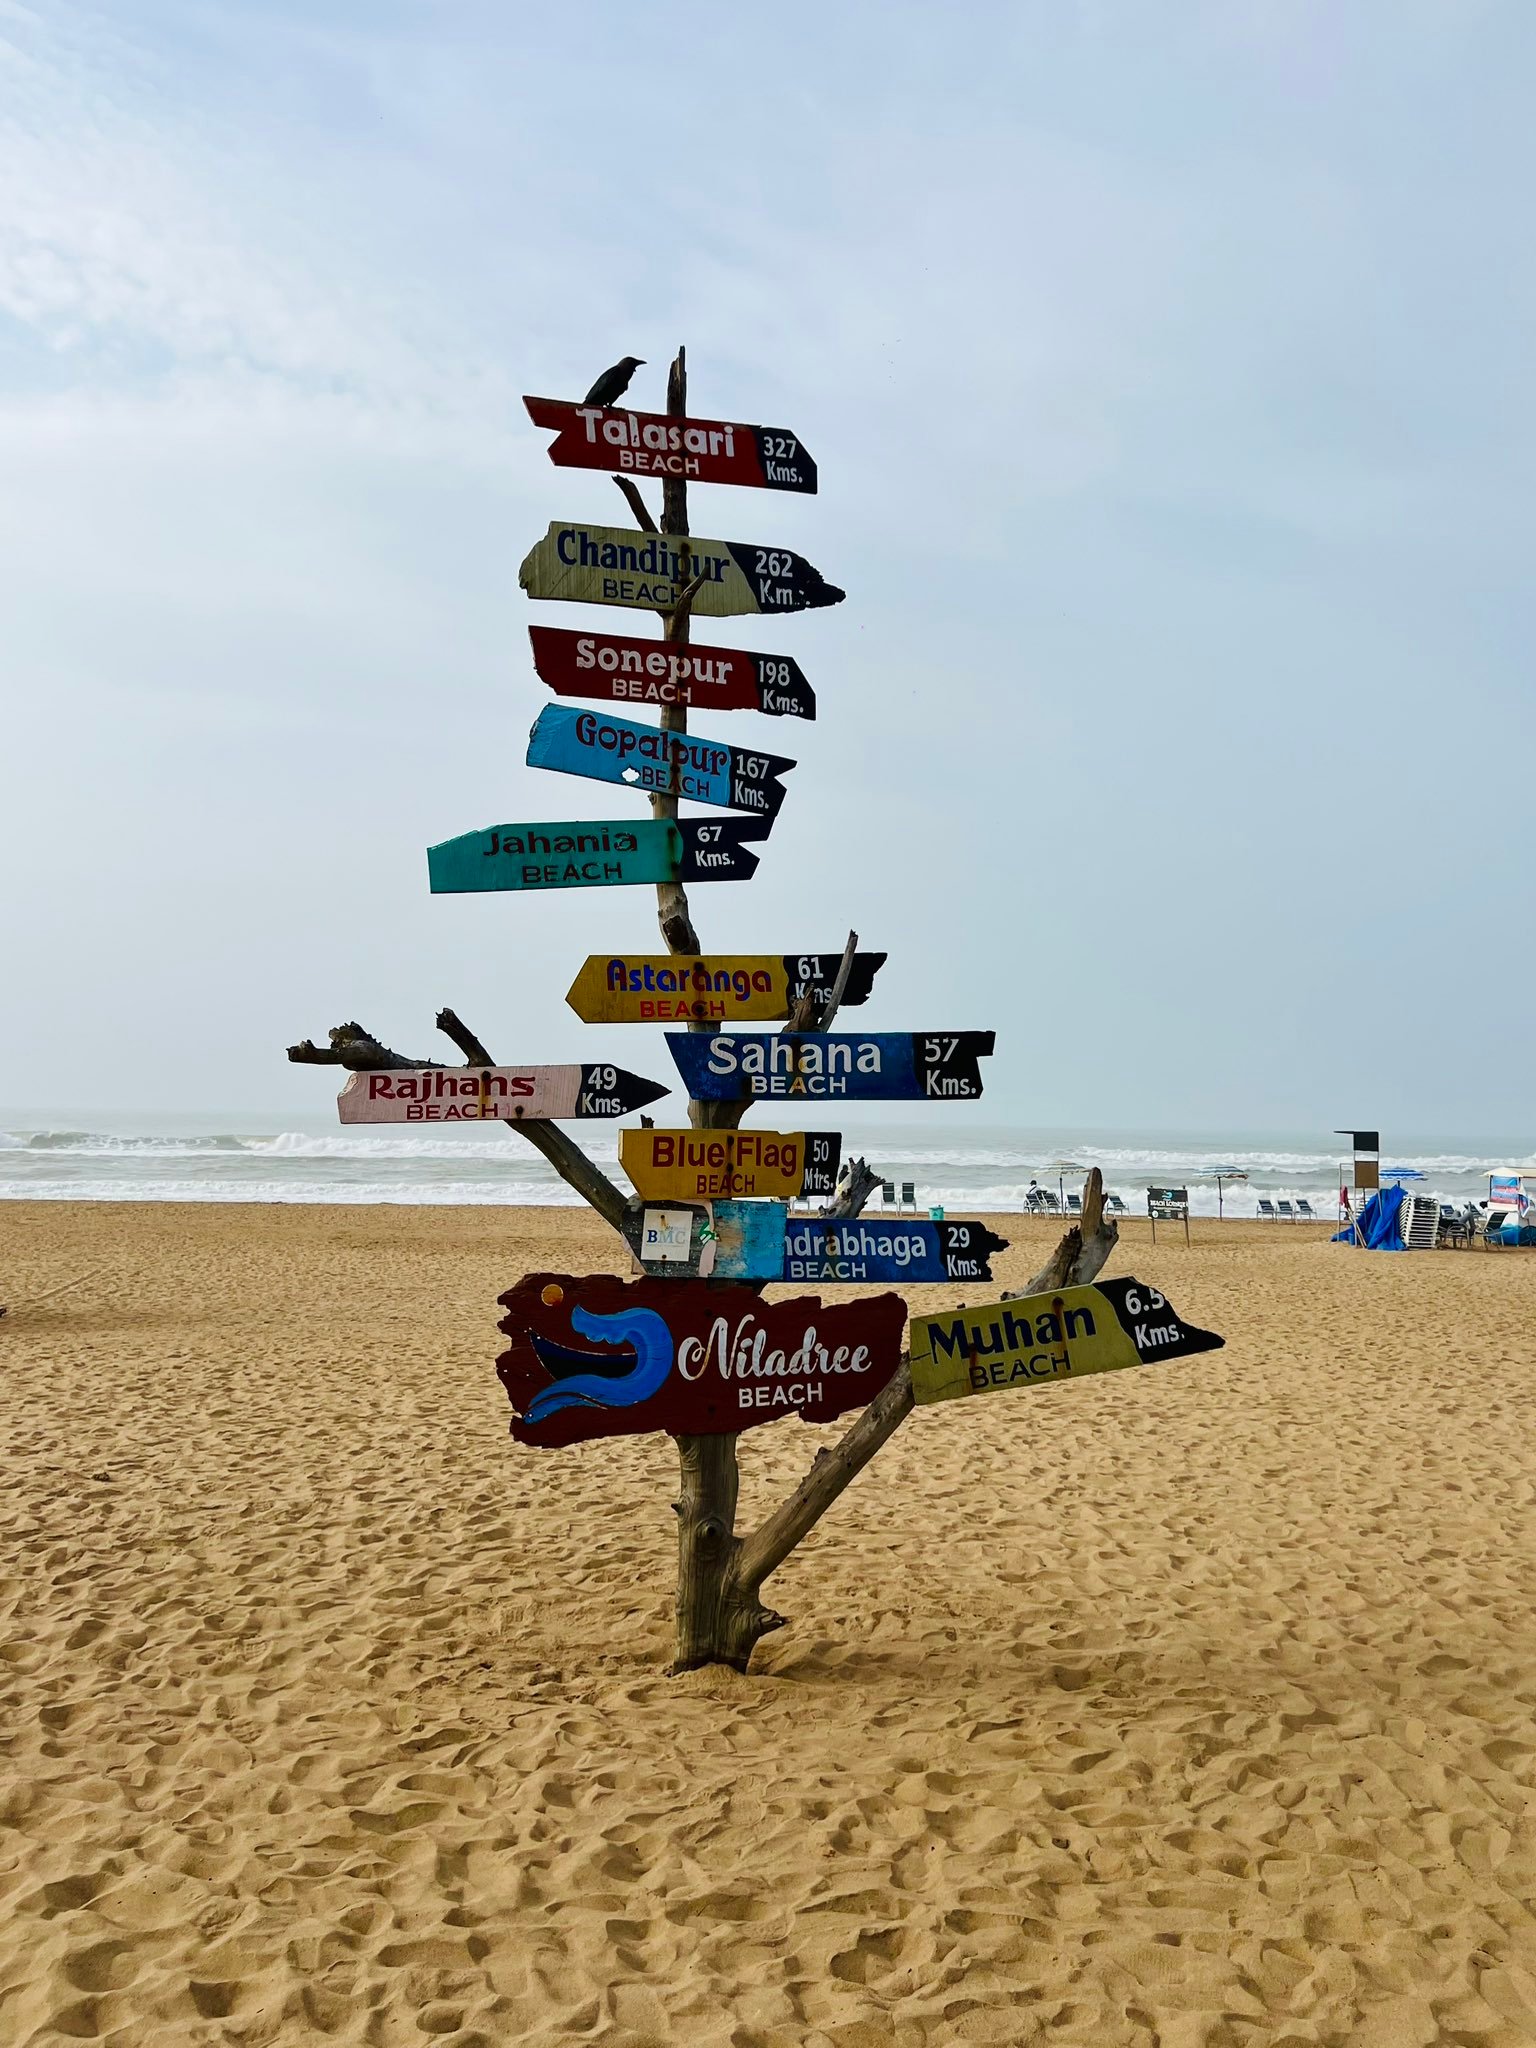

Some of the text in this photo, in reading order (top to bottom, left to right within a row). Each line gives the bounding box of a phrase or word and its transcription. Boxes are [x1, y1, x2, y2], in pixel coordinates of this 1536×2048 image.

[576, 408, 735, 457] Talasari
[763, 436, 797, 459] 327
[619, 450, 700, 475] BEACH
[766, 461, 804, 483] Kms.
[556, 529, 730, 584] Chandipur
[755, 550, 793, 578] 262
[576, 639, 733, 685] Sonepur
[758, 660, 790, 686] 198
[612, 678, 692, 703] BEACH
[763, 689, 804, 713] Kms.
[575, 713, 729, 776] Gopalpur
[736, 755, 770, 780] 167
[641, 765, 710, 798] BEACH
[734, 779, 769, 809] Kms.
[483, 827, 639, 857] Jahania
[697, 826, 723, 843] 67
[695, 850, 735, 868] Kms.
[521, 862, 623, 884] BEACH
[797, 956, 824, 979] 61
[607, 959, 773, 1002] Astaranga
[639, 1000, 726, 1018] BEACH
[707, 1036, 882, 1074] Sahana
[924, 1038, 960, 1062] 57
[369, 1075, 536, 1104] Rajhans
[588, 1067, 617, 1090] 49
[751, 1076, 847, 1094] BEACH
[926, 1069, 976, 1096] Kms.
[406, 1103, 498, 1120] BEACH
[581, 1091, 628, 1115] Kms.
[652, 1135, 797, 1178] Blue Flag
[813, 1139, 829, 1162] 50
[696, 1174, 755, 1195] BEACH
[647, 1229, 686, 1245] BMC
[784, 1227, 927, 1266] ndrabhaga
[947, 1227, 970, 1249] 29
[790, 1261, 867, 1279] BEACH
[946, 1254, 982, 1277] Kms.
[1124, 1288, 1165, 1316] 6.5
[677, 1313, 873, 1381] Niladree
[928, 1305, 1097, 1365] Muhan
[1134, 1322, 1185, 1349] Kms.
[968, 1350, 1072, 1389] BEACH
[738, 1382, 824, 1409] BEACH
